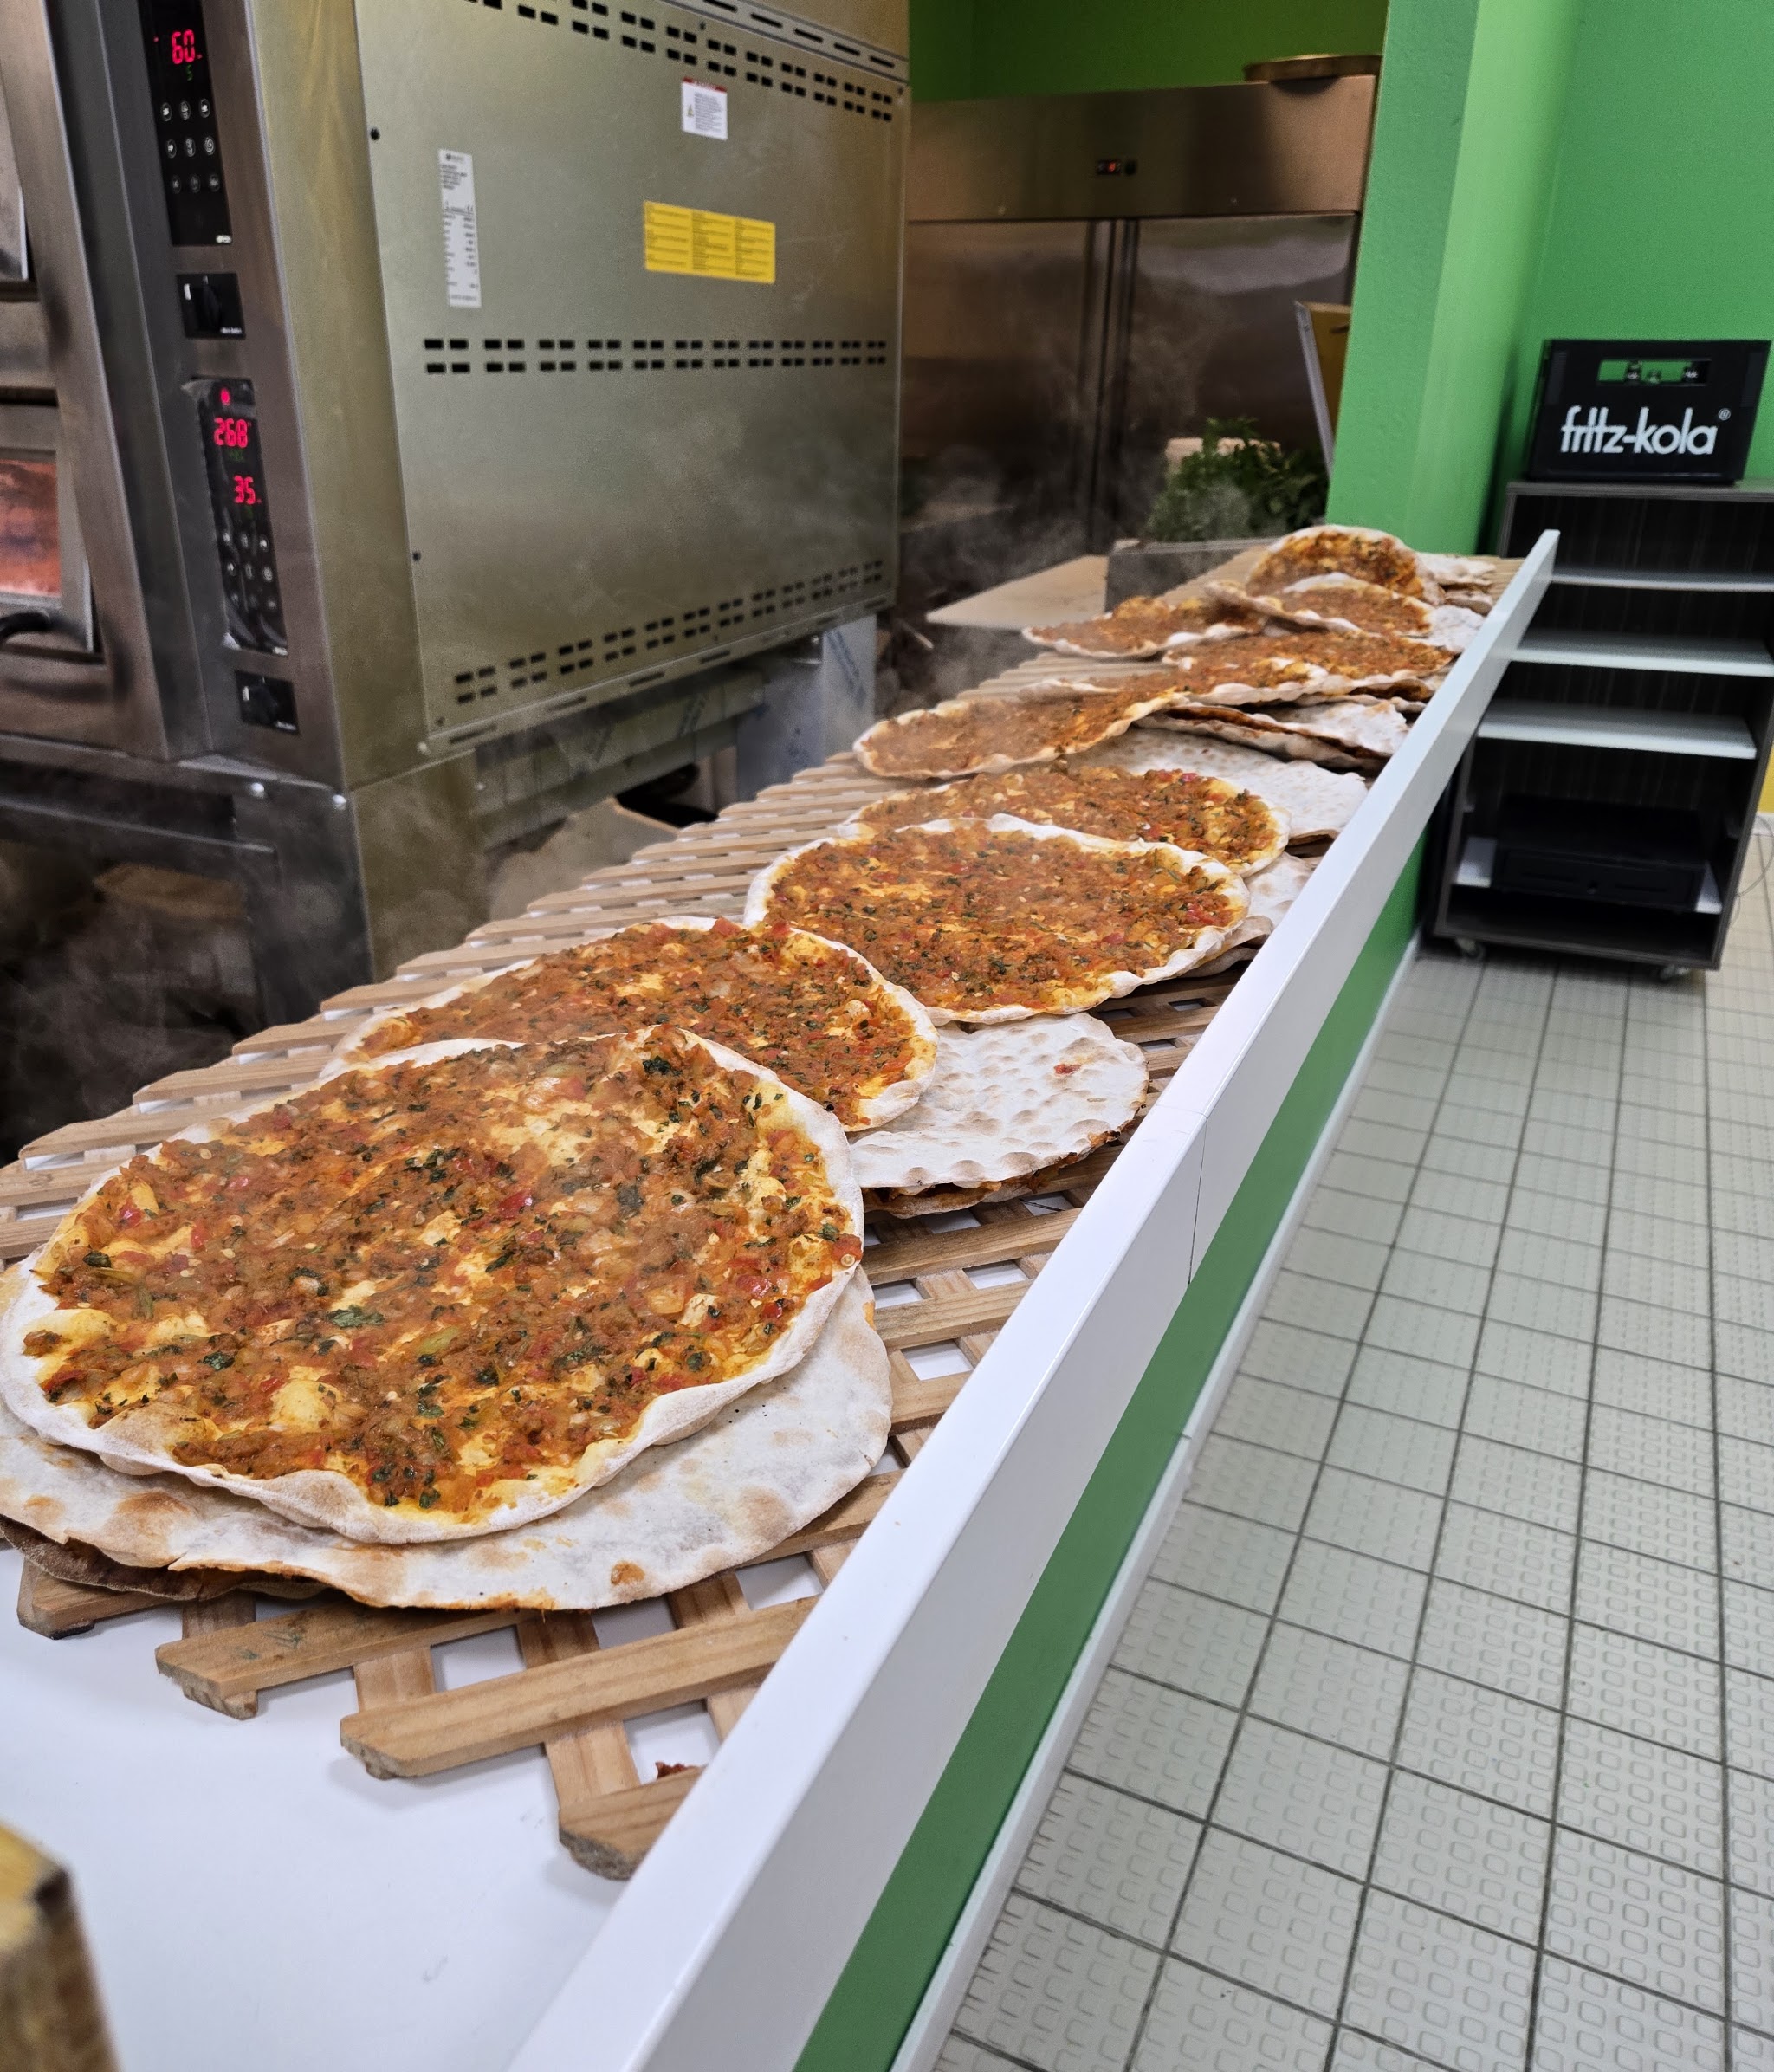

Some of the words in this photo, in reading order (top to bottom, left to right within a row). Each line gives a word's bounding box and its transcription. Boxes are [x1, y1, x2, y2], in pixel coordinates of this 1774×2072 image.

[172, 29, 195, 65] 60
[214, 417, 248, 448] 268
[1560, 405, 1719, 455] fritz-kola
[234, 475, 256, 505] 35
